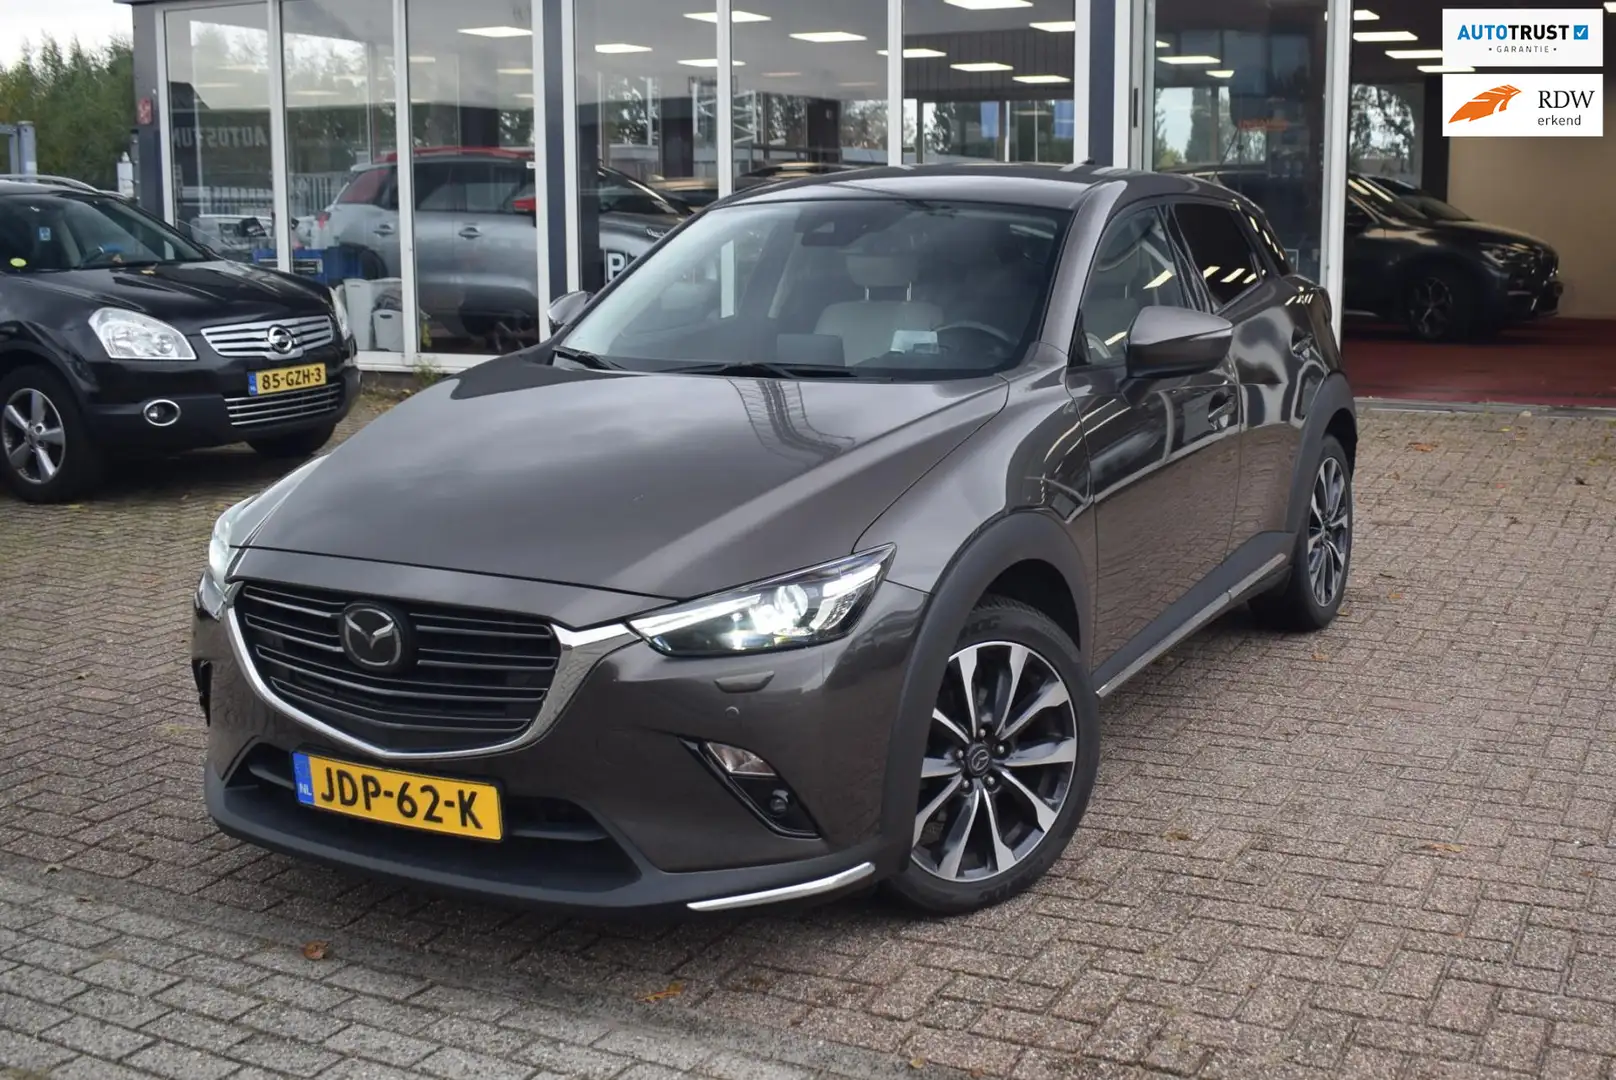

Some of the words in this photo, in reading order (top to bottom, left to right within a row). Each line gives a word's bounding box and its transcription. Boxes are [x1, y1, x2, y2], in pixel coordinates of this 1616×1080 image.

[262, 367, 322, 390] 85-GZH-3
[299, 782, 313, 797] NL
[321, 766, 483, 830] JDP-62-K
